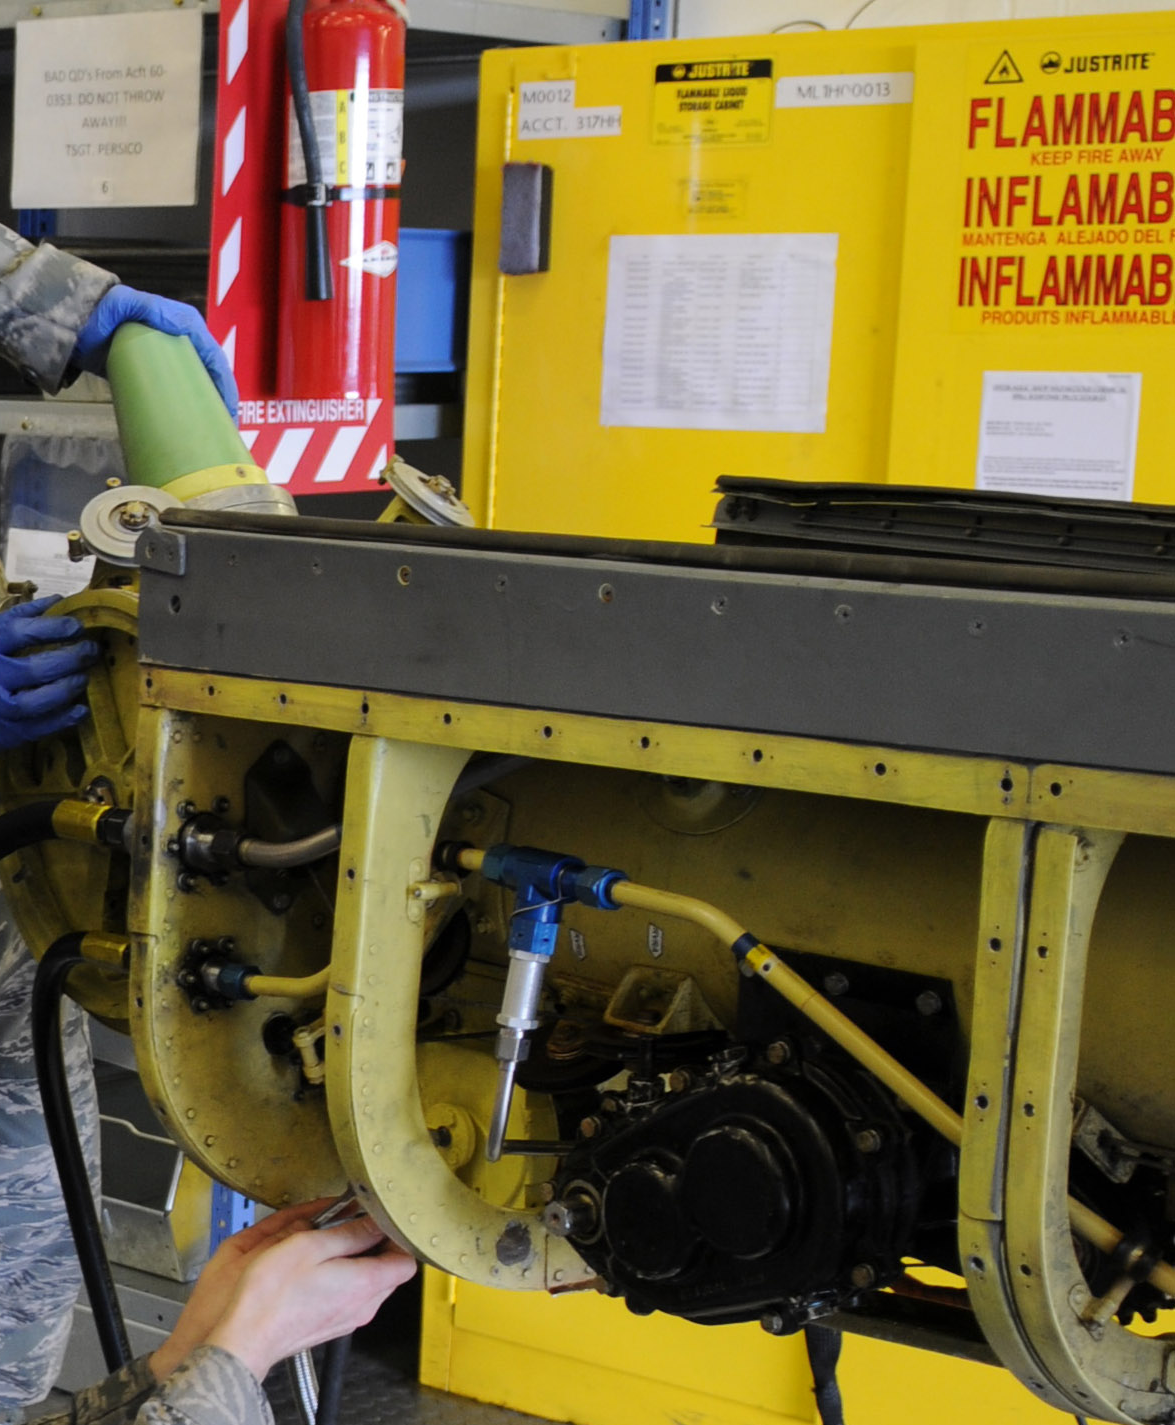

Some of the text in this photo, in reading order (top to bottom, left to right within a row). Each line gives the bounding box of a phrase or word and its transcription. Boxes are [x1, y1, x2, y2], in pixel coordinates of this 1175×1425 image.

[1064, 53, 1150, 73] JUSTRITE
[44, 70, 66, 83] BAD
[95, 67, 123, 81] From
[78, 92, 95, 106] DO
[97, 91, 119, 105] NOT
[123, 89, 166, 103] THROW
[522, 88, 572, 105] M0012
[98, 142, 143, 155] PERSICO
[1031, 147, 1164, 166] KEEP FIRE AWAY
[963, 171, 1174, 228] INFLAMAB
[962, 231, 1047, 247] MANTENGA
[1057, 229, 1129, 246] ALEJADO
[1134, 229, 1164, 244] DEL
[958, 253, 1174, 307] INFLAMMAB
[981, 310, 1060, 325] PRODUITS
[238, 399, 364, 424] FIRE EXTINGUISHER
